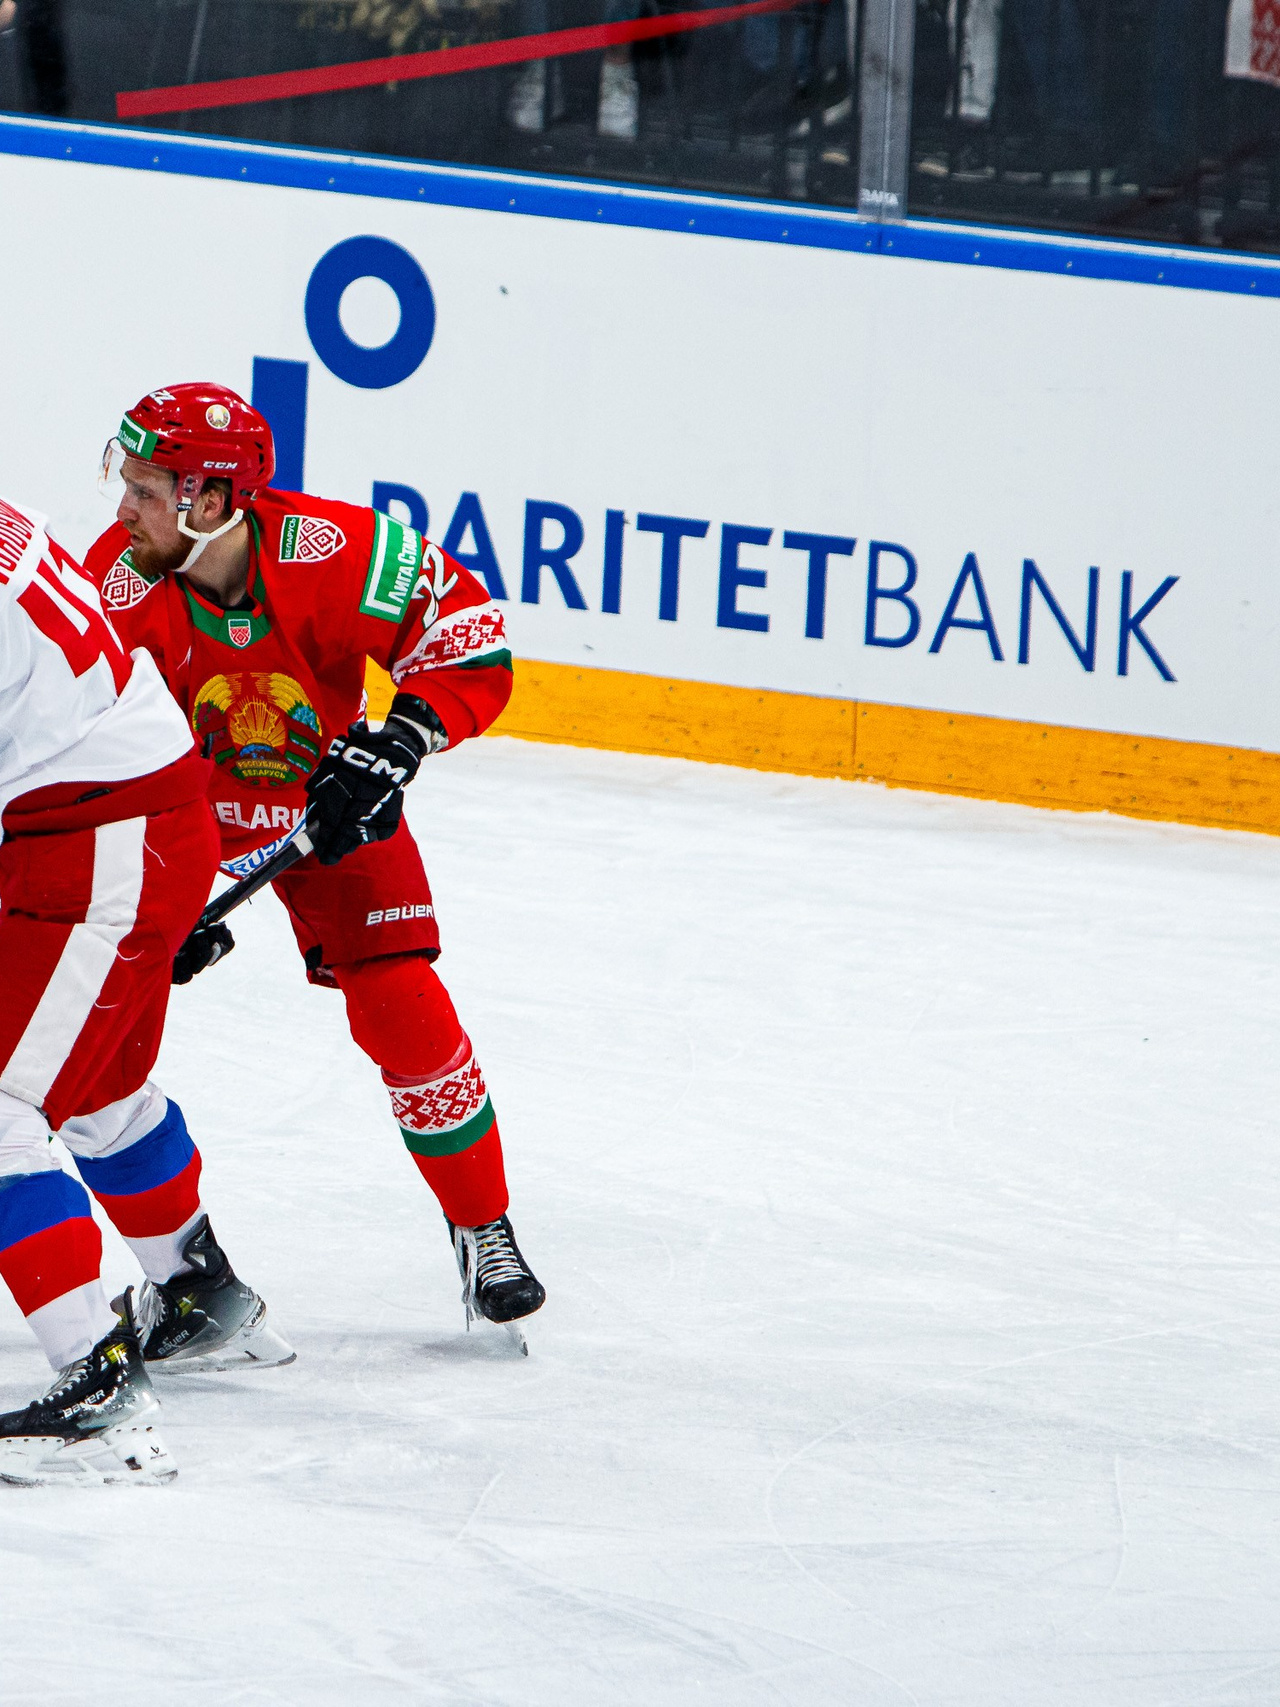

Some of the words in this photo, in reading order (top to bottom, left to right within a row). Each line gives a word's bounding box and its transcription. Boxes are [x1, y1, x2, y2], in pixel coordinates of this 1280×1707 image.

[203, 460, 238, 470] CCM
[285, 517, 297, 559] БЕЛАРУСЬ
[370, 479, 1180, 683] PARITETBANK
[327, 737, 408, 784] CCM
